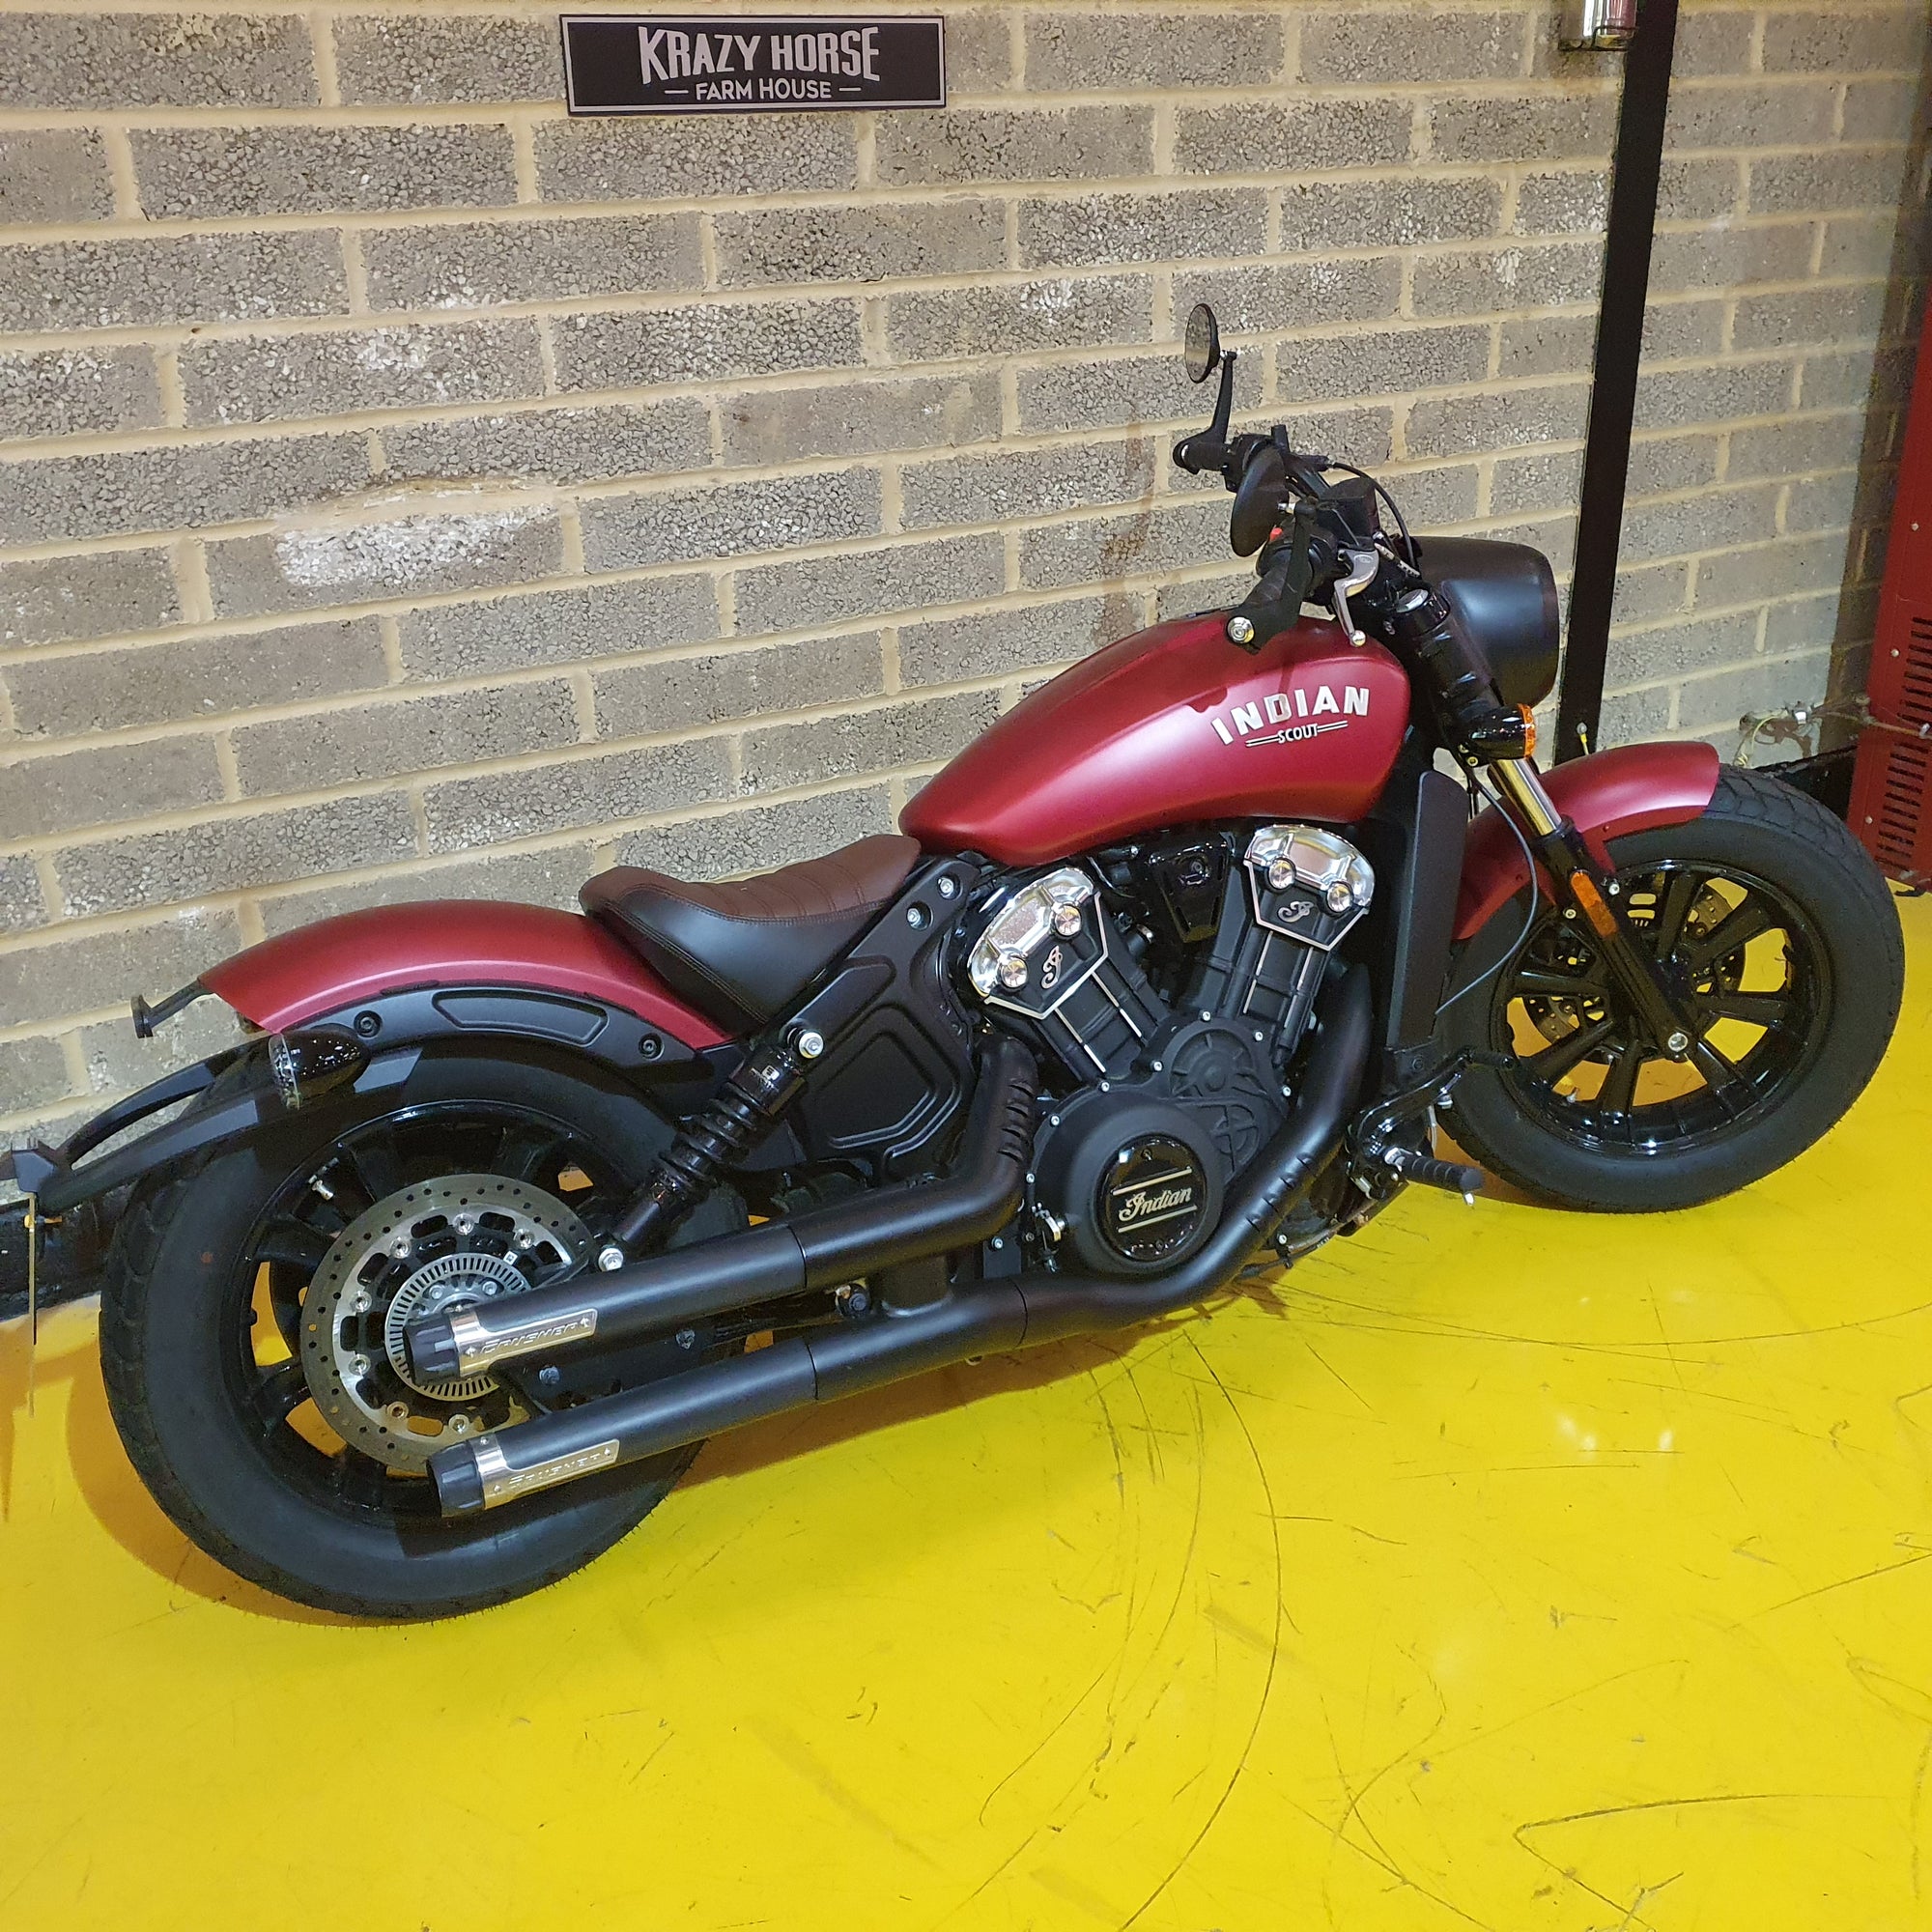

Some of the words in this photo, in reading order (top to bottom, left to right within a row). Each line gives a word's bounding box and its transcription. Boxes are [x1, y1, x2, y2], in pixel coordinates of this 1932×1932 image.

[639, 27, 760, 84] KRAZY
[771, 27, 880, 81] HORSE
[696, 80, 753, 100] FARM
[759, 78, 832, 99] HOUSE
[1211, 685, 1370, 745] INDIAN
[1277, 723, 1319, 744] SCOUT
[1118, 1187, 1192, 1221] Indian
